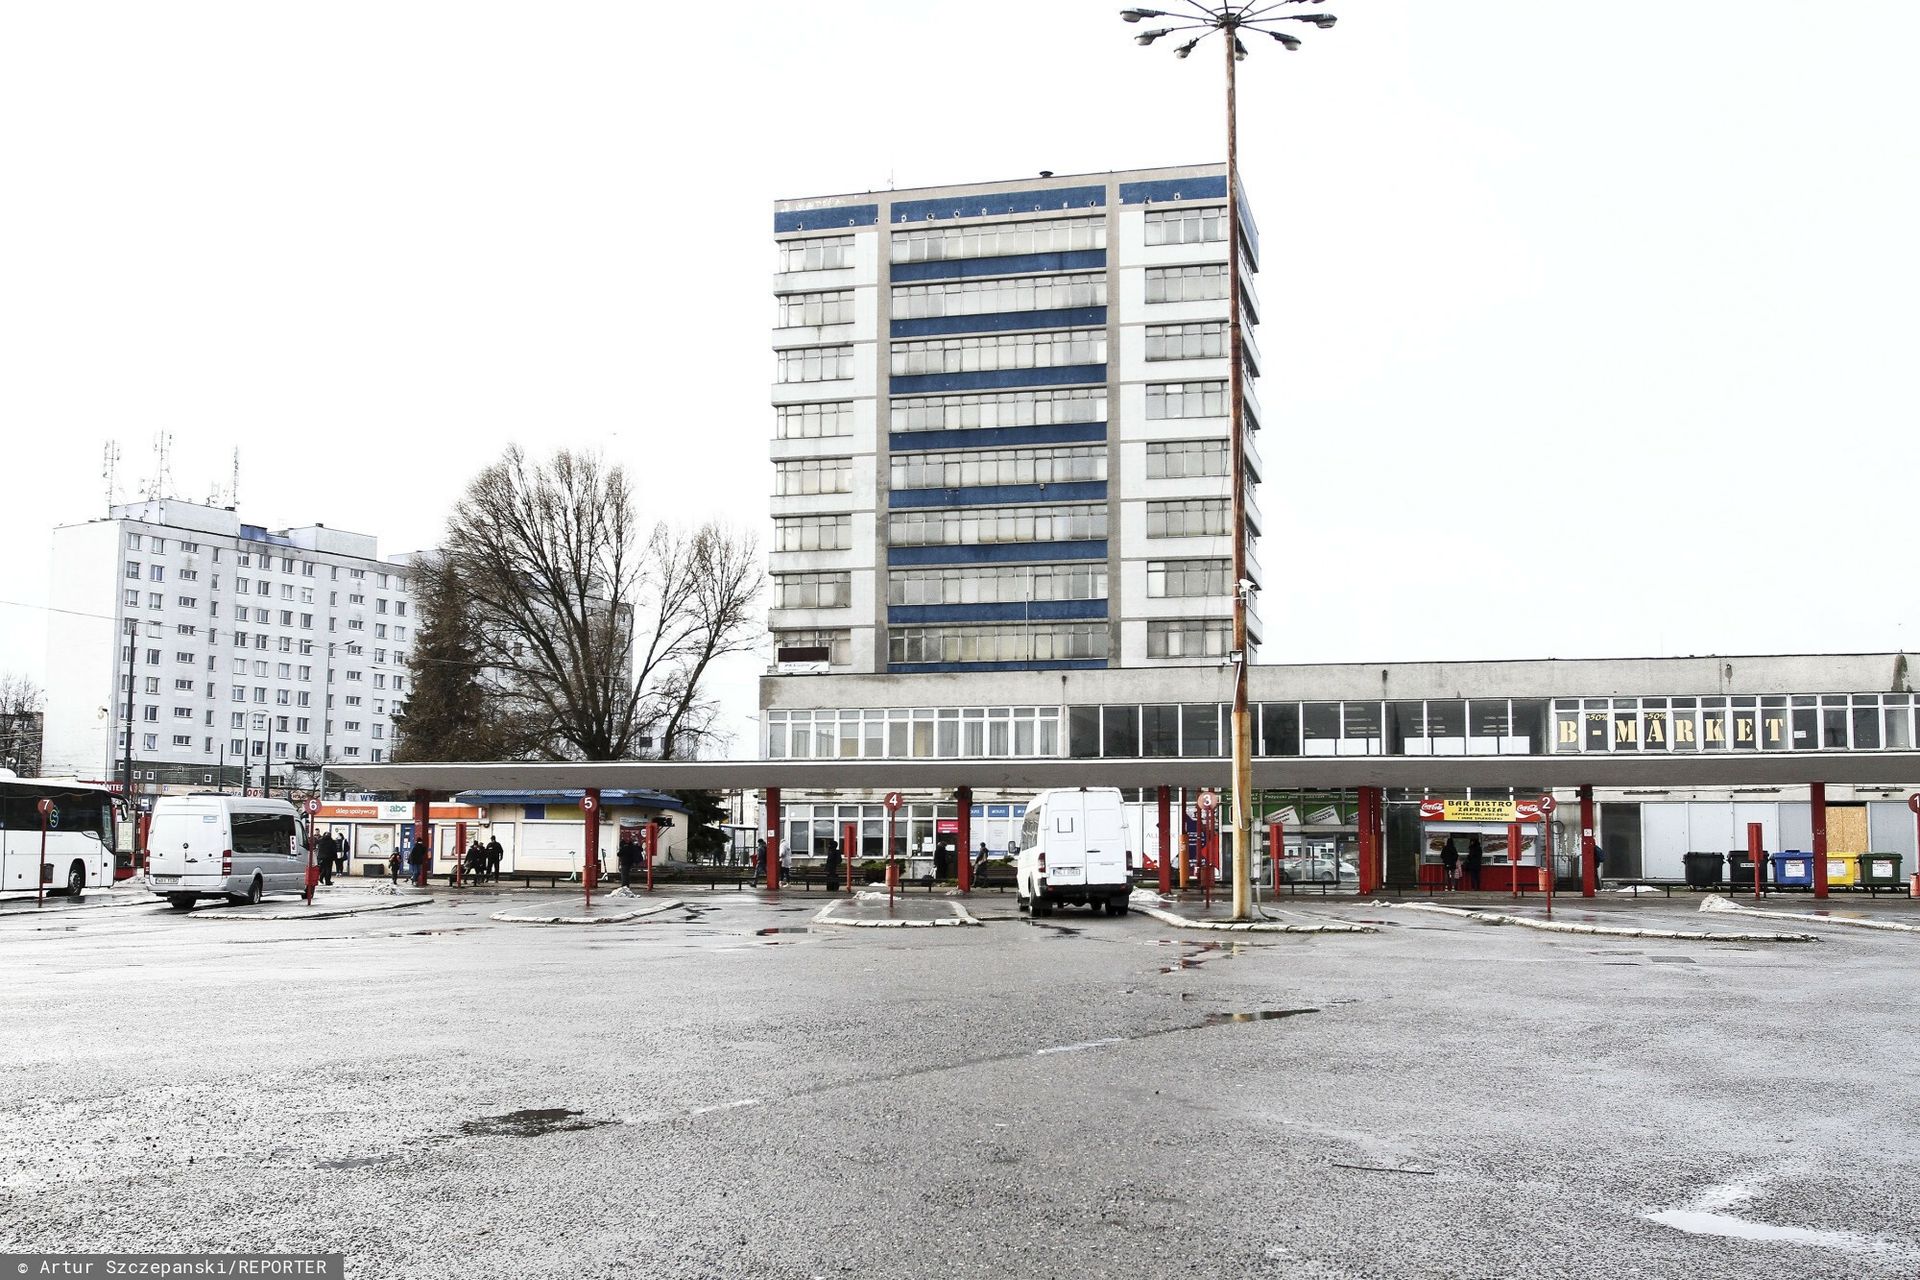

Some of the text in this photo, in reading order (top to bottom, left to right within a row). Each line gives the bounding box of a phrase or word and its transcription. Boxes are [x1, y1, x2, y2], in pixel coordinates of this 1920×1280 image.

[43, 799, 50, 810] 7
[308, 799, 318, 811] 6
[584, 797, 593, 809] 5
[889, 794, 898, 807] 4
[1203, 794, 1212, 806] 3
[1542, 797, 1551, 810] 2
[1914, 795, 1920, 808] 1
[389, 804, 407, 813] abc
